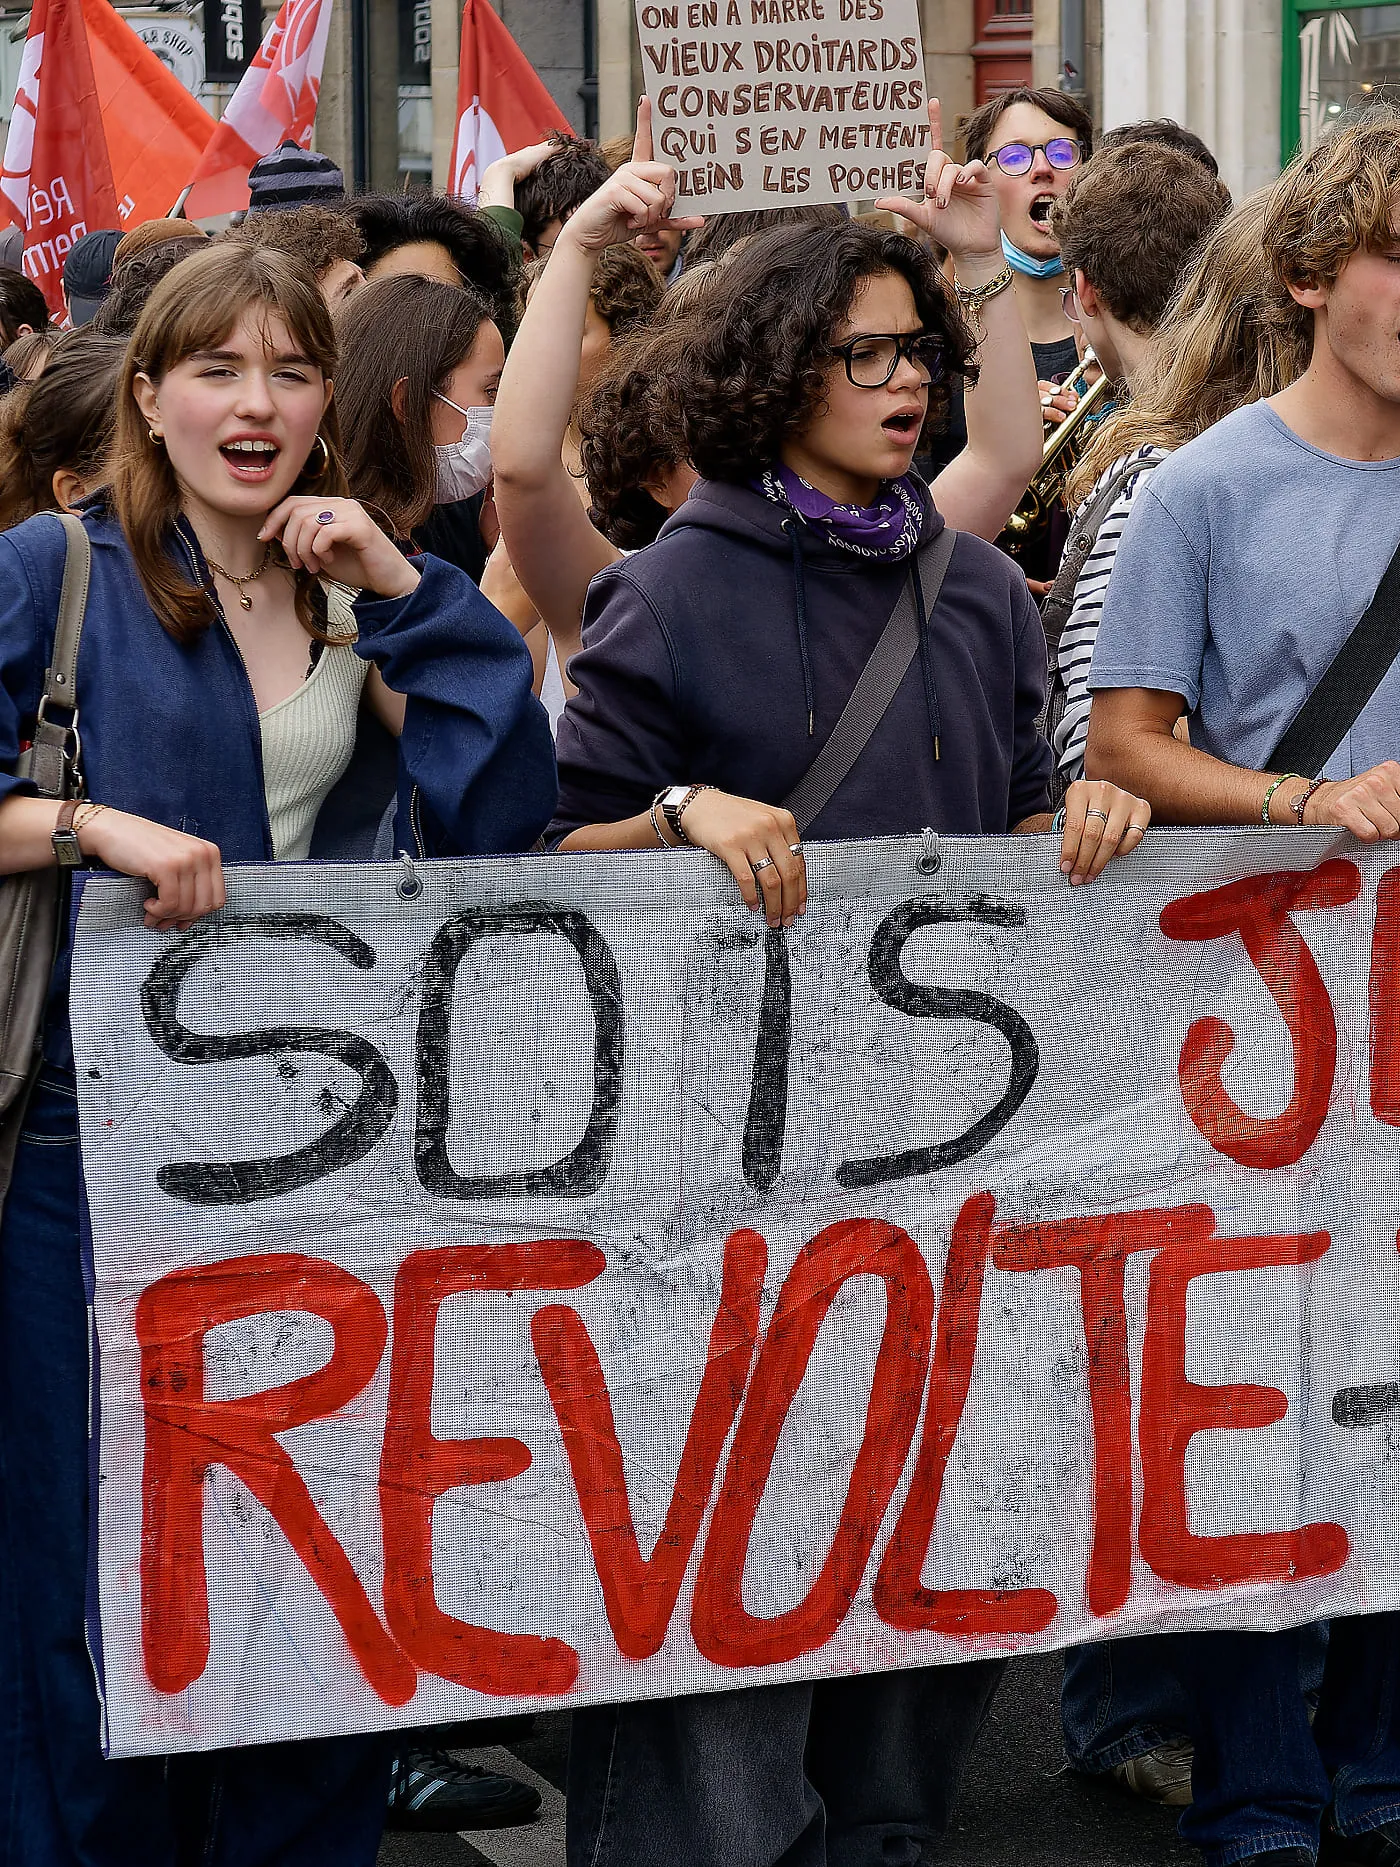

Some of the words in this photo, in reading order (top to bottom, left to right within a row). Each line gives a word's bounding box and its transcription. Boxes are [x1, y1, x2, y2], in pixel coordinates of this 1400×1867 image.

[641, 5, 679, 29] ON
[687, 1, 718, 28] EN
[726, 0, 742, 25] A
[750, 0, 825, 24] MARRE
[839, 0, 884, 21] DES
[658, 81, 923, 118] CONSERVATEURS
[819, 121, 931, 149] METTENT
[763, 166, 811, 194] LES
[828, 159, 928, 193] POCHES
[140, 891, 1040, 1204] SOIS
